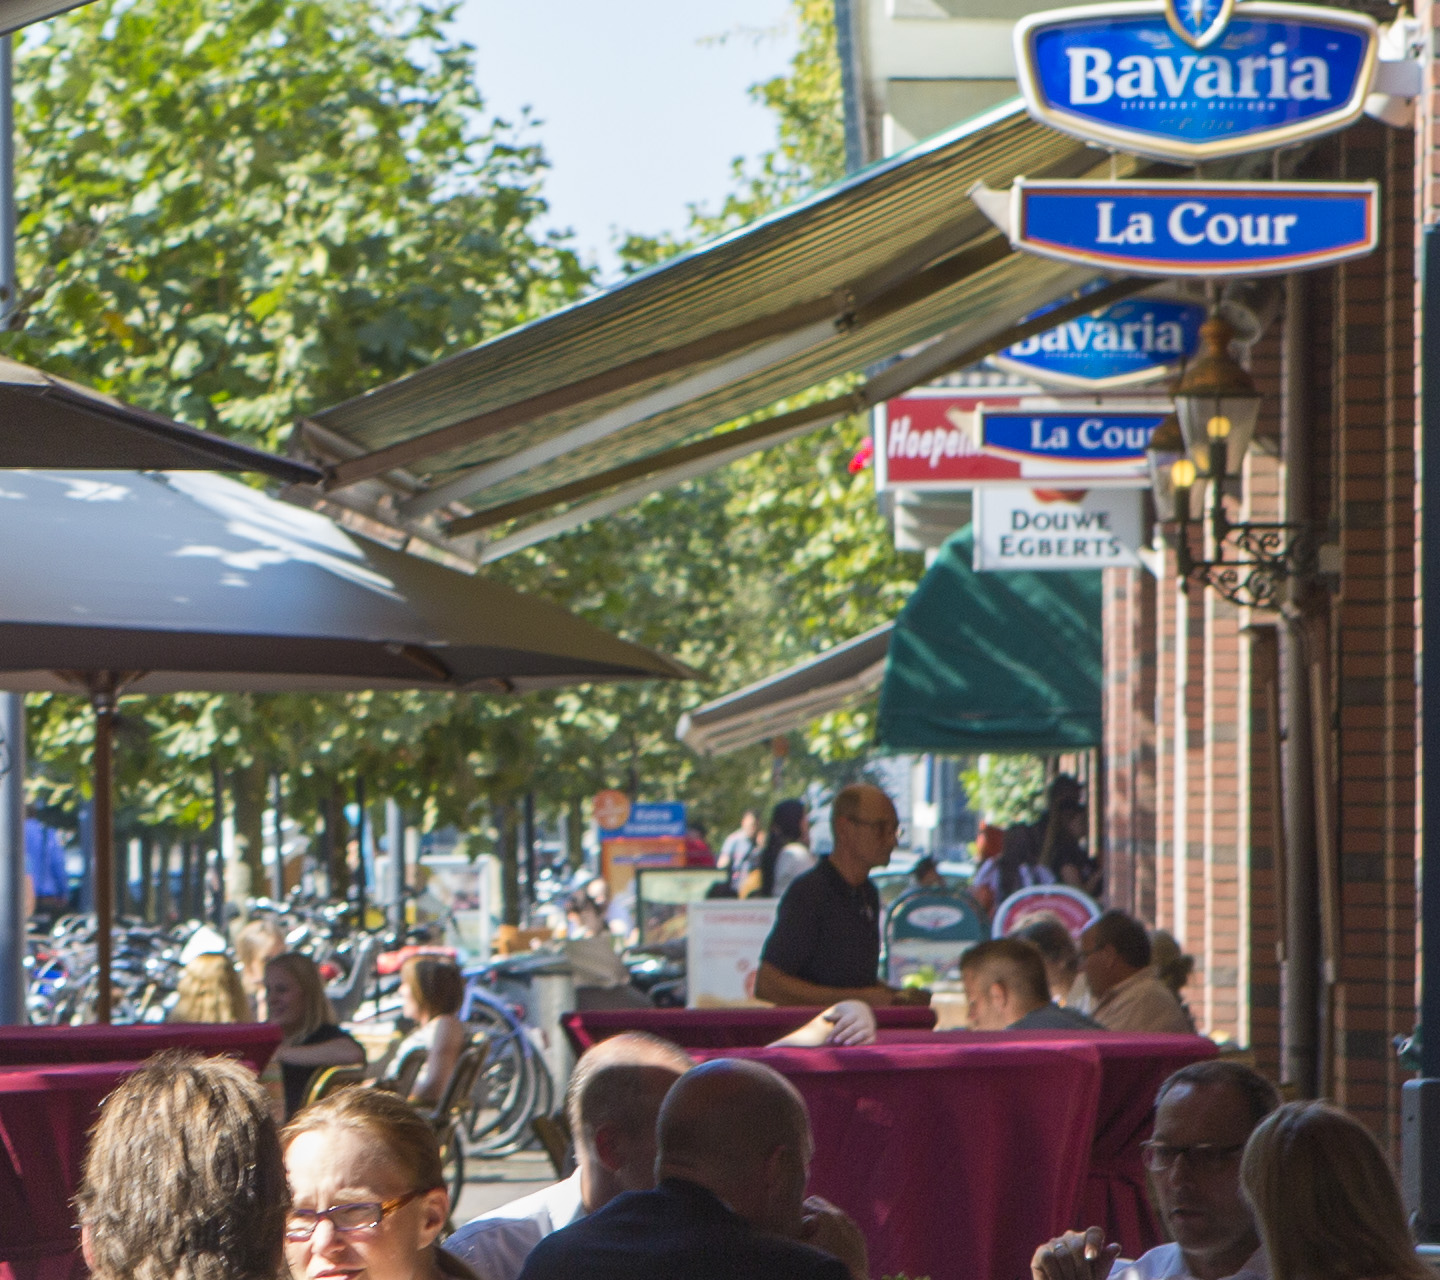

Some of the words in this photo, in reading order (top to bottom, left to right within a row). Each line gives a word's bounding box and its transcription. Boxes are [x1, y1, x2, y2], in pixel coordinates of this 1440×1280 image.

[1066, 43, 1332, 107] Bavaria
[1095, 202, 1154, 245] La
[1168, 202, 1298, 246] Cour
[1030, 419, 1069, 449] La
[1011, 510, 1111, 531] DOUWE
[999, 535, 1121, 558] EGBERTS
